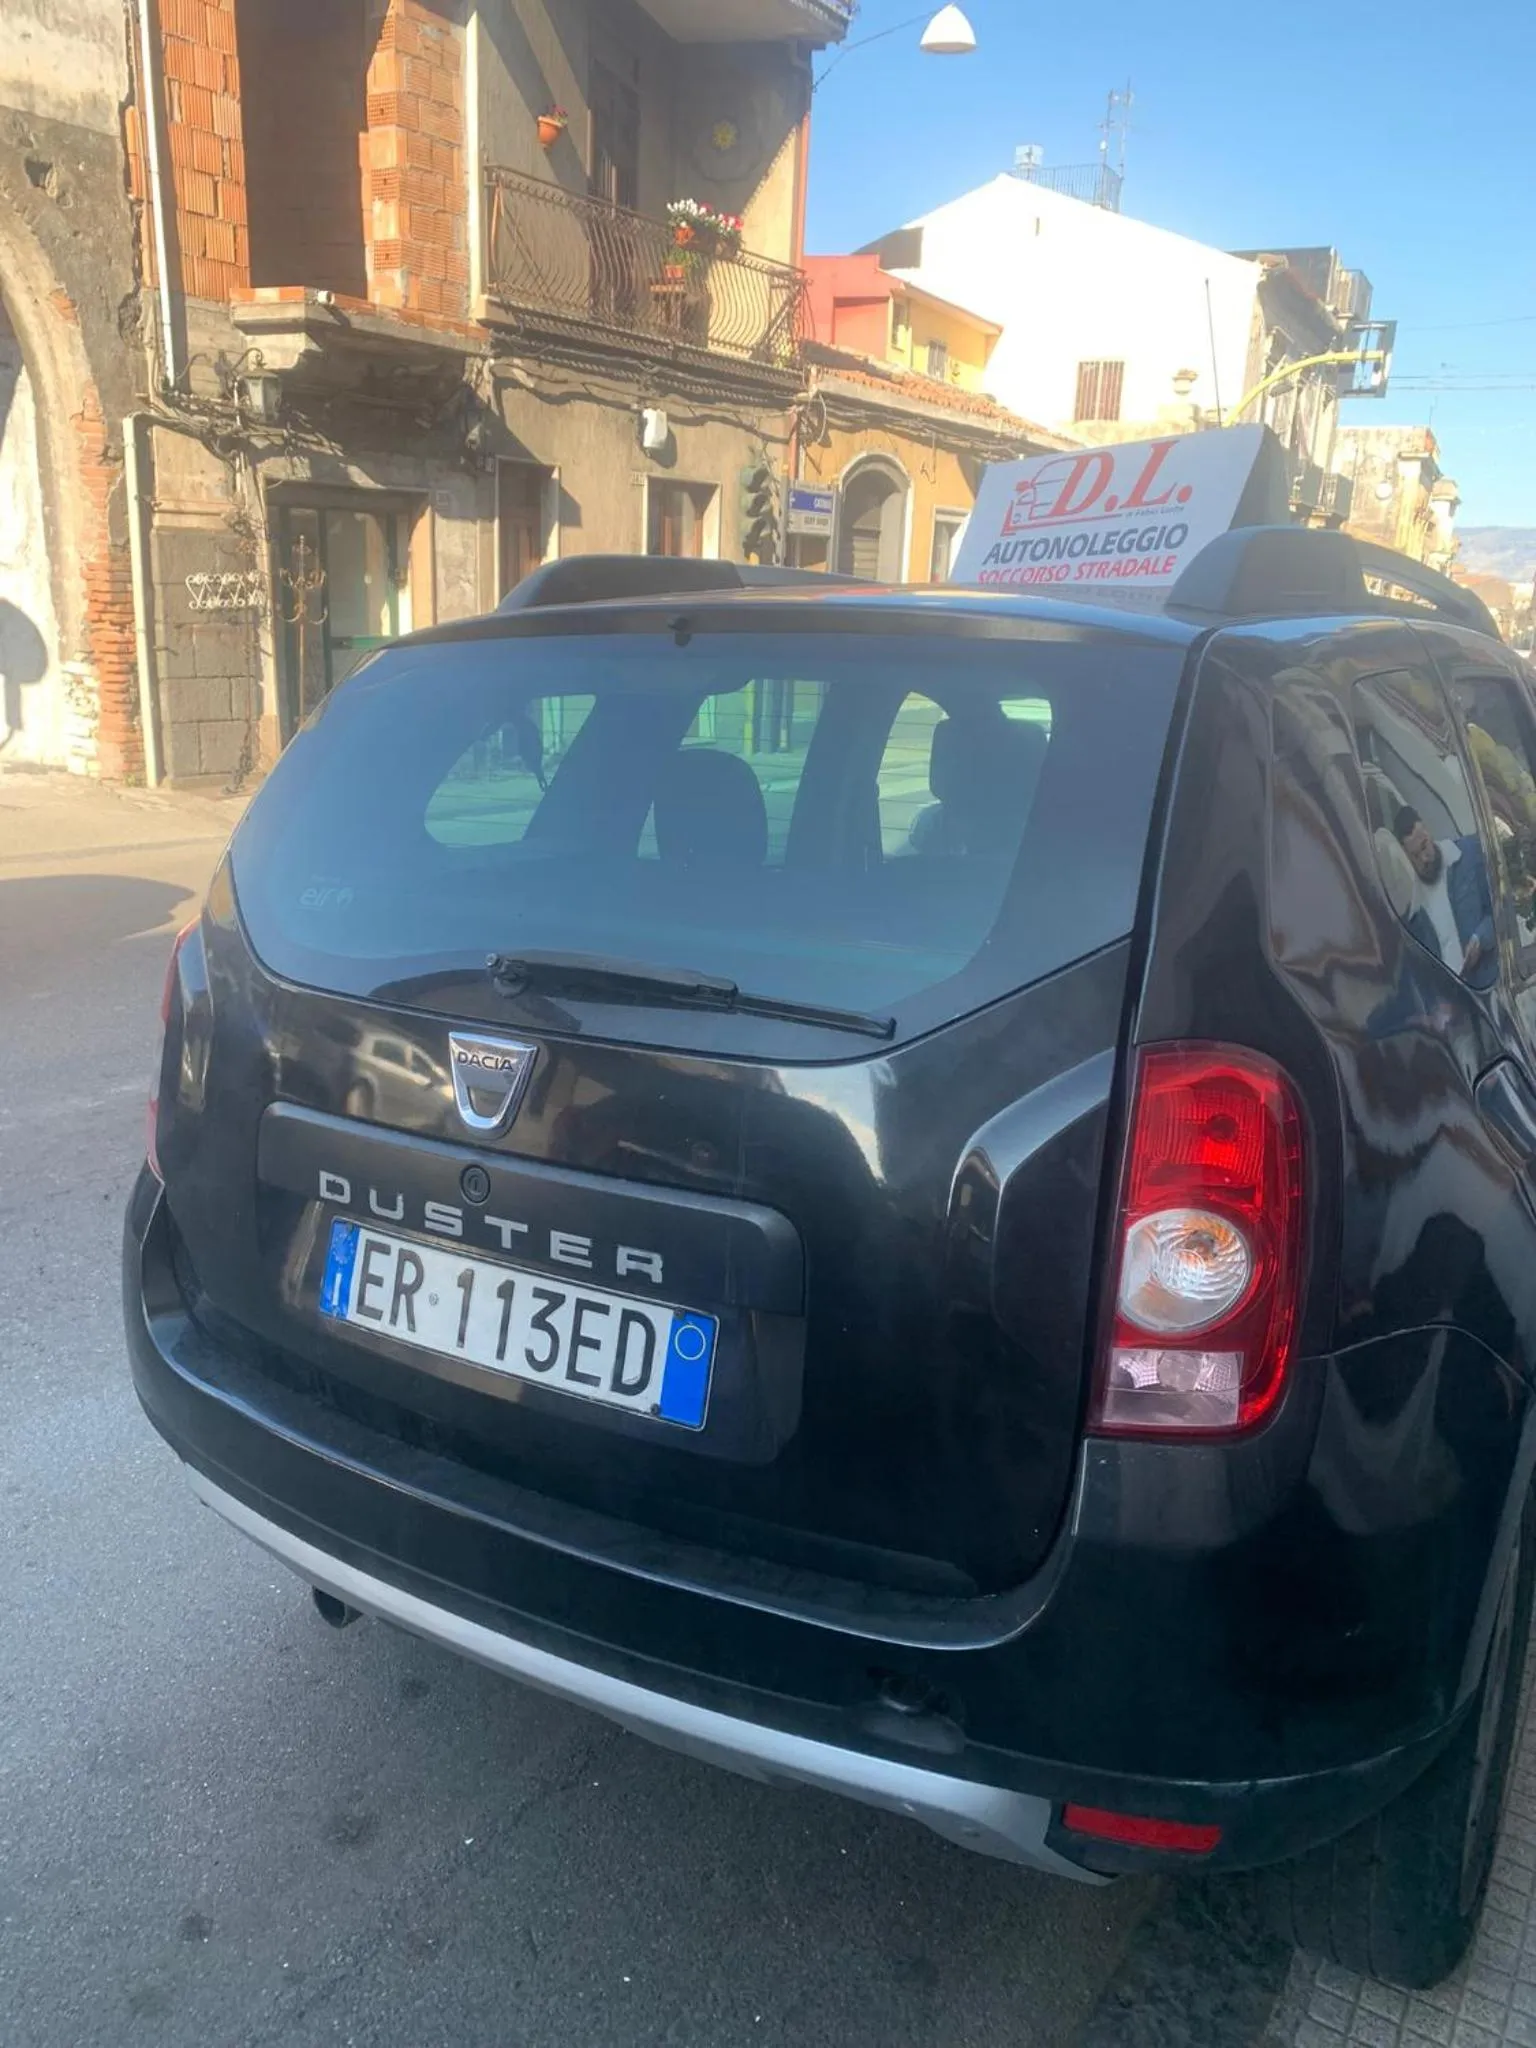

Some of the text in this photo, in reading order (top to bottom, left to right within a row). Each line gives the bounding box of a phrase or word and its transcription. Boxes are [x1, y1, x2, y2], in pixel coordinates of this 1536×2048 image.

[1049, 440, 1193, 518] D.L.
[982, 523, 1189, 566] AUTONOLEGGIO
[978, 555, 1177, 585] SOCCORSO STRADALE
[457, 1051, 513, 1072] DACIA
[318, 1169, 664, 1284] DUSTER
